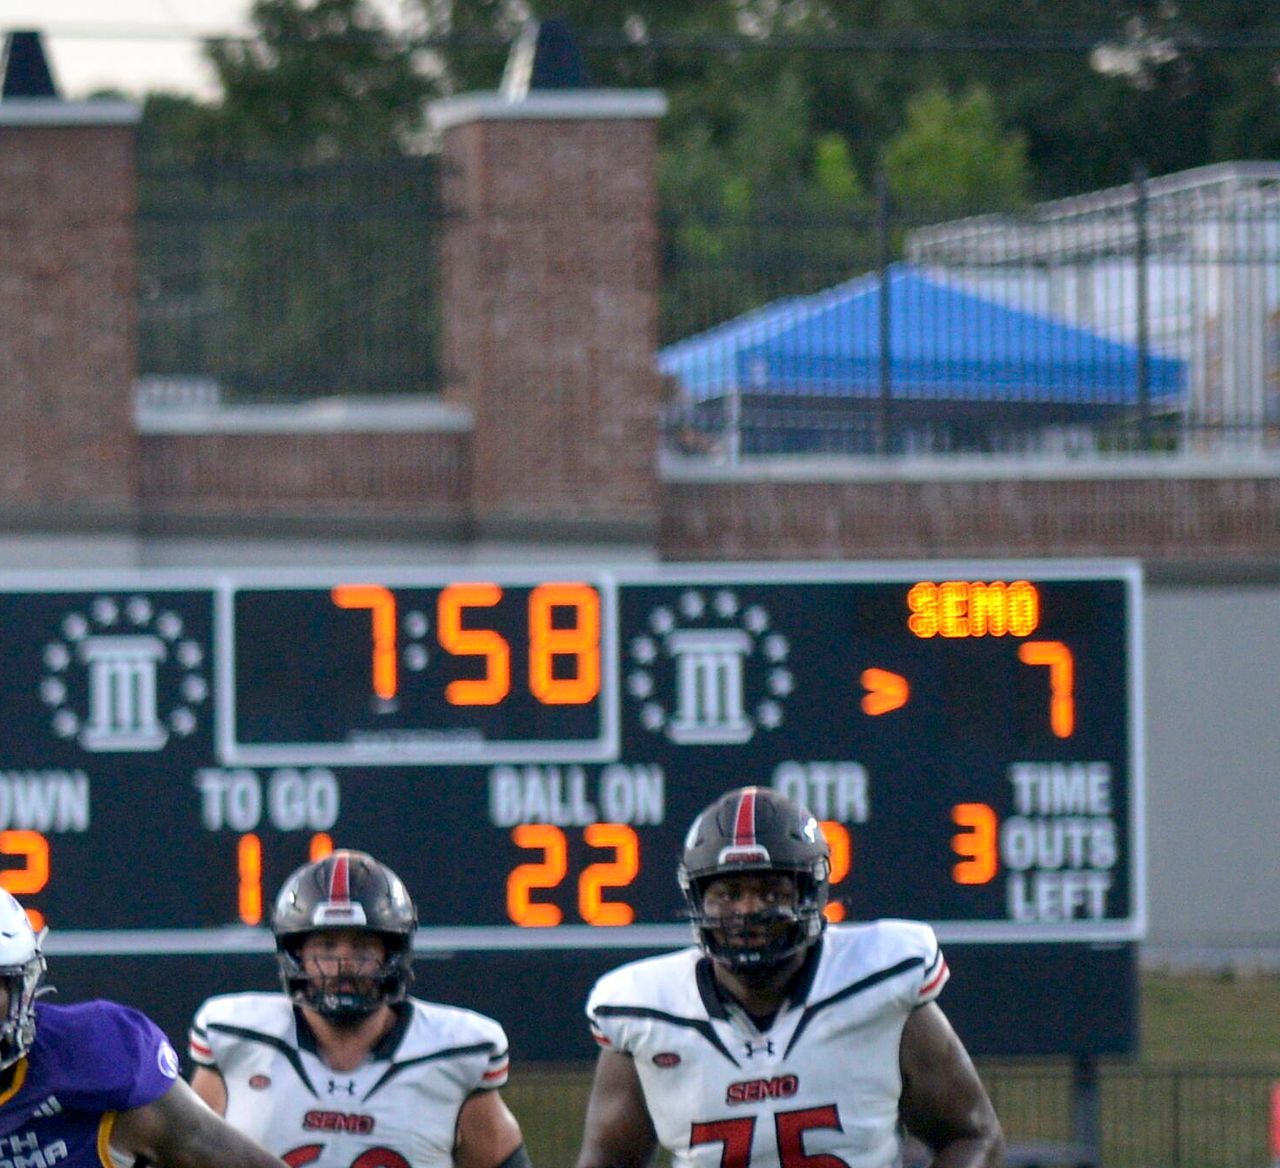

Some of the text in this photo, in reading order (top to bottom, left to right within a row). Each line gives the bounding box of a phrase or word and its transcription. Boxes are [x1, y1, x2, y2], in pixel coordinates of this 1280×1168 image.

[907, 580, 1038, 638] SEMO
[331, 581, 600, 705] 7:58
[1017, 640, 1074, 738] 7
[196, 769, 340, 831] TO GO
[489, 764, 665, 827] BALL ON
[1009, 762, 1113, 815] TIME
[951, 803, 999, 885] 3
[1000, 820, 1118, 873] OUTS
[506, 823, 639, 928] 22
[1007, 875, 1113, 921] LEFT
[725, 1072, 800, 1106] SEMO
[302, 1110, 376, 1135] SEMO
